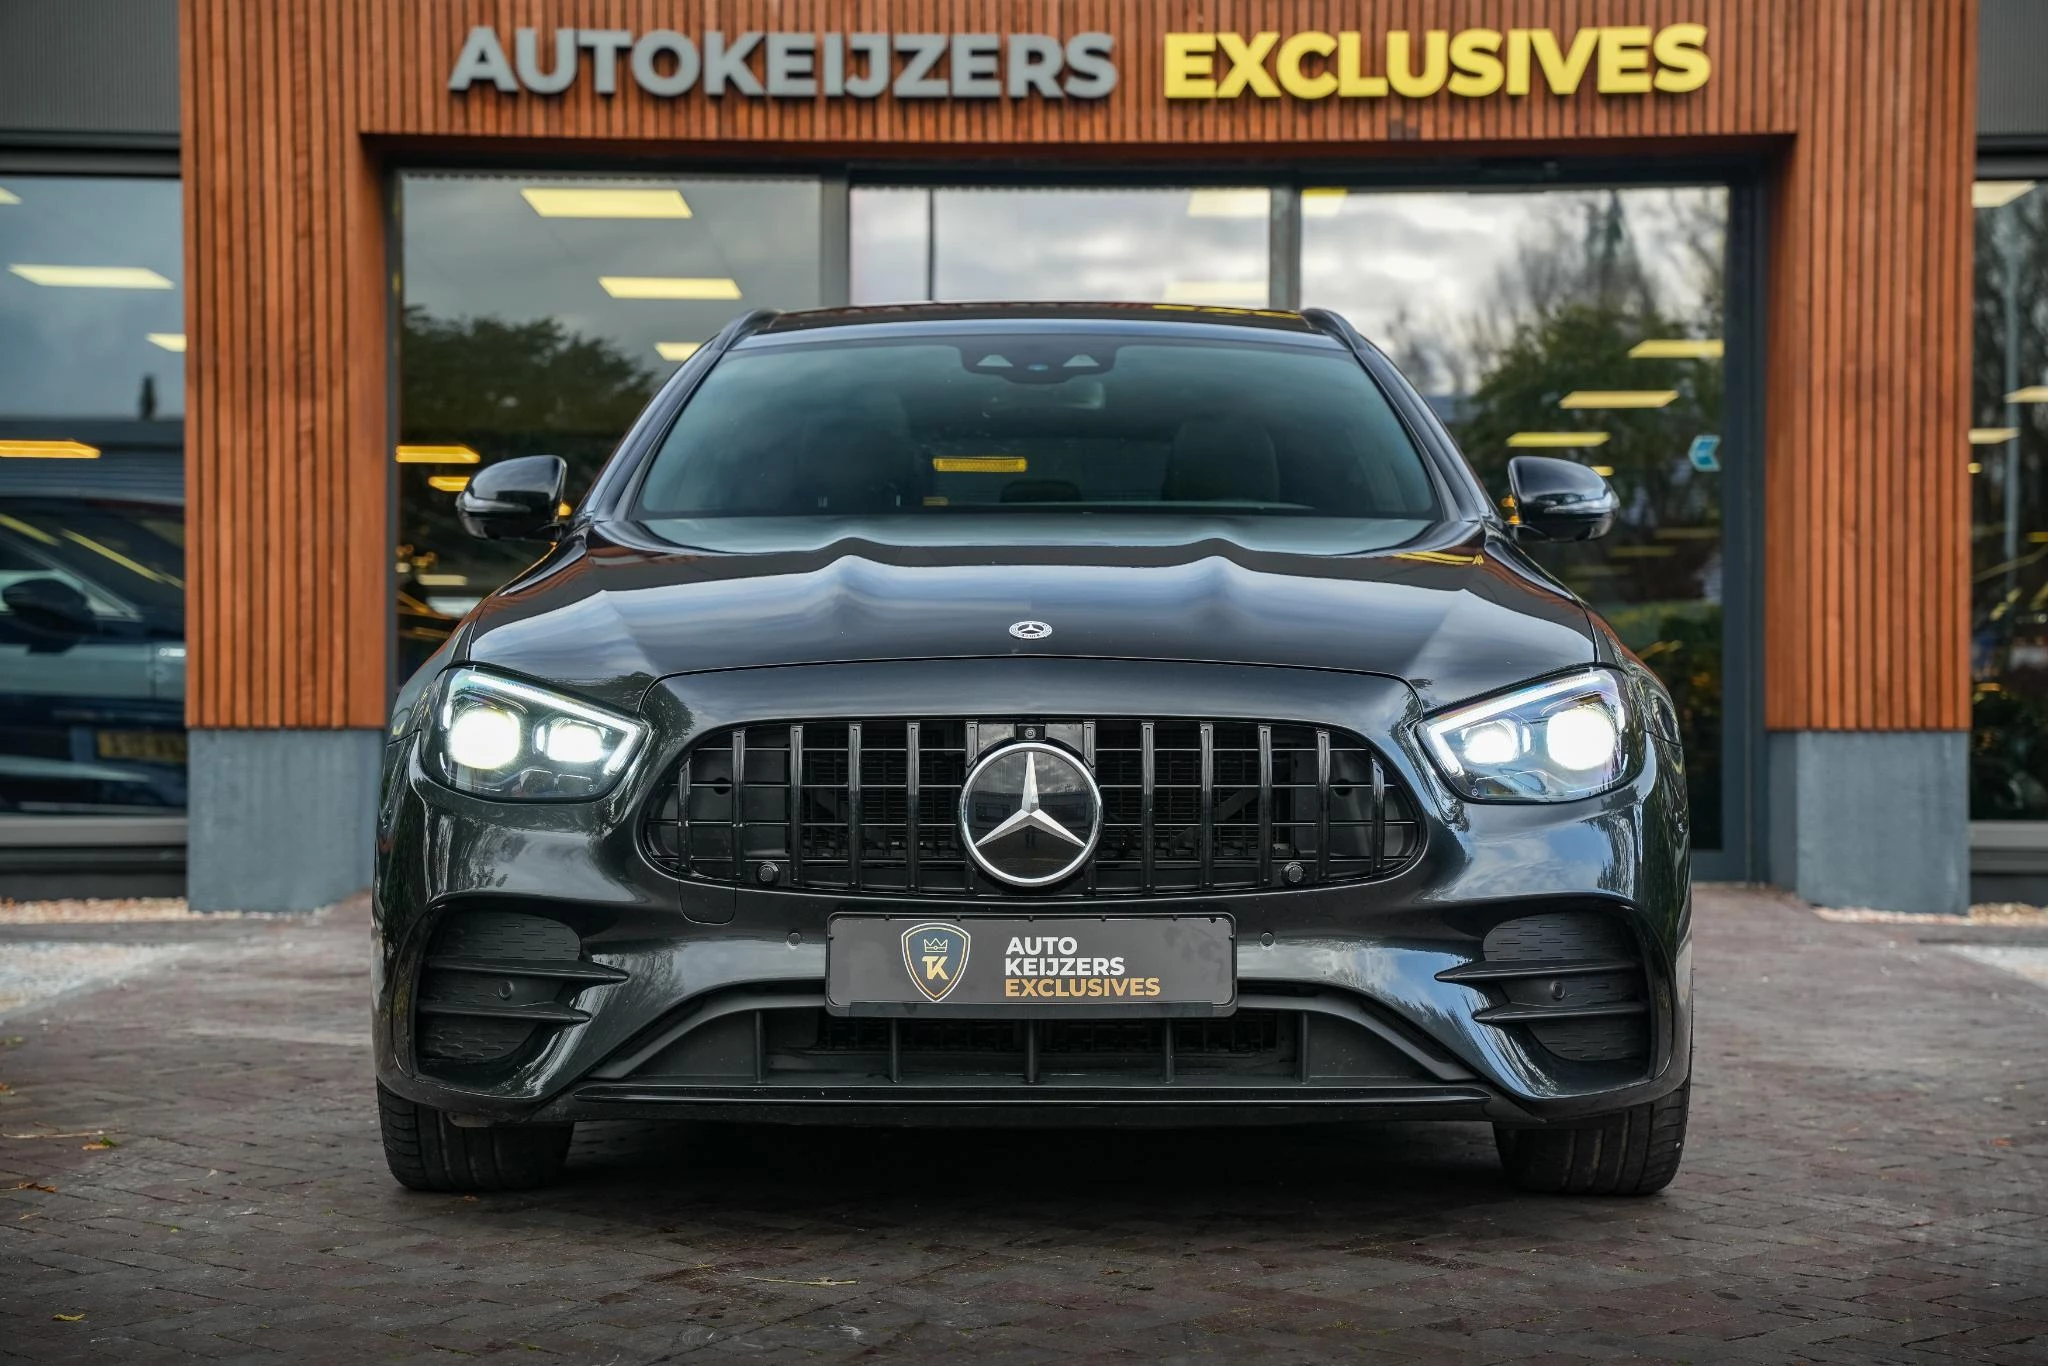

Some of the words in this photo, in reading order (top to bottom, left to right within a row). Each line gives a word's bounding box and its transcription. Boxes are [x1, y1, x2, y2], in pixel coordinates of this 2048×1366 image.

[447, 25, 1119, 99] AUTOKEIJZERS
[1163, 22, 1712, 100] EXCLUSIVES
[1005, 936, 1078, 955] AUTO
[1005, 956, 1126, 976] KEIJZERS
[1005, 977, 1161, 998] EXCLUSIVES
